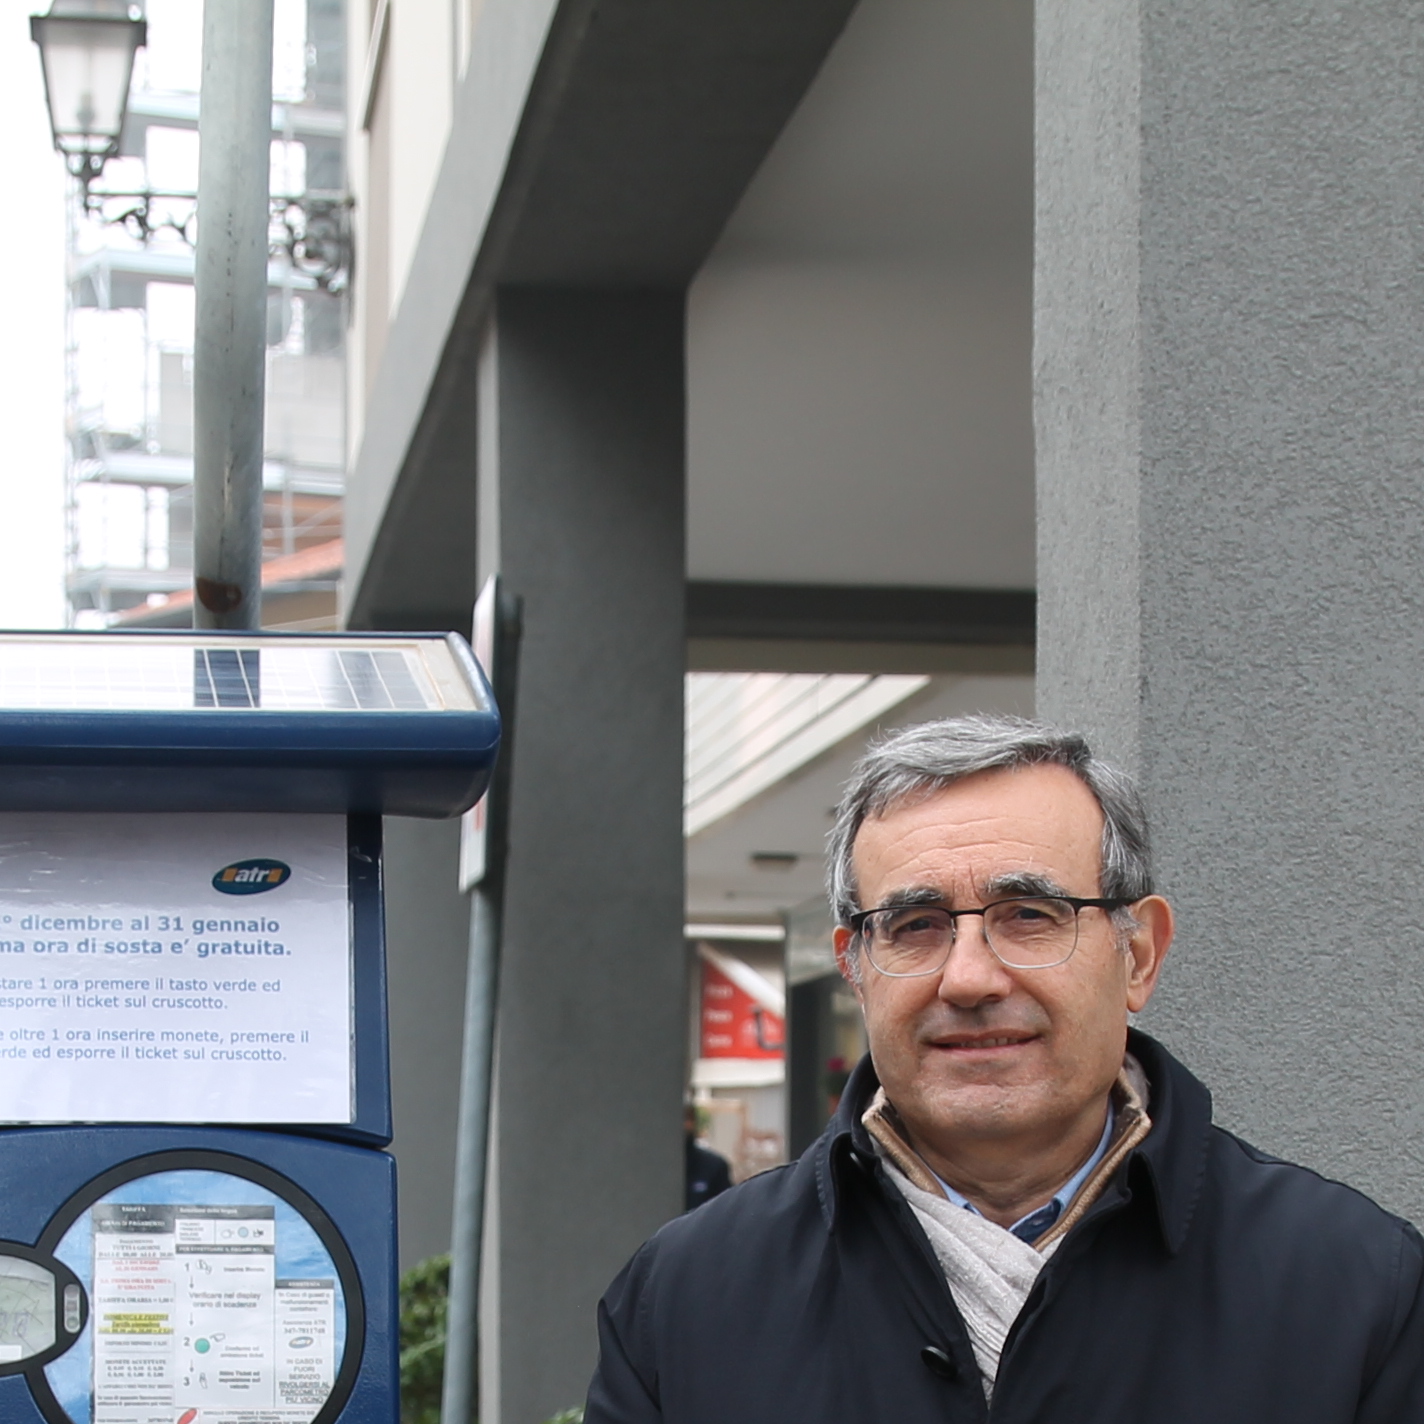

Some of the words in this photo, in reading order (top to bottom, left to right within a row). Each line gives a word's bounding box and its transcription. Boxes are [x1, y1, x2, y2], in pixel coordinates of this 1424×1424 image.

[20, 915, 123, 931] dicembre
[131, 916, 149, 931] al
[157, 916, 184, 931] 31
[192, 917, 280, 935] gennaio
[33, 941, 69, 953] ora
[76, 938, 97, 953] di
[104, 940, 163, 954] sosta
[197, 939, 292, 958] gratuita.
[39, 978, 47, 990] 1
[53, 979, 79, 990] ora
[84, 979, 150, 992] premere
[155, 977, 164, 990] il
[169, 979, 208, 991] tasto
[213, 979, 257, 992] verde
[262, 979, 281, 992] ed
[62, 995, 71, 1007] il
[76, 995, 119, 1008] ticket
[125, 995, 147, 1008] sul
[152, 997, 228, 1009] cruscotto.
[9, 1028, 45, 1041] oltre
[52, 1029, 60, 1041] 1
[66, 1031, 91, 1041] ora
[97, 1028, 155, 1041] inserire
[161, 1030, 224, 1044] monete,
[230, 1031, 296, 1044] premere
[301, 1030, 310, 1043] il
[32, 1046, 51, 1059] ed
[57, 1048, 116, 1061] esporre
[121, 1046, 129, 1059] il
[135, 1046, 177, 1060] ticket
[183, 1047, 205, 1060] sul
[211, 1049, 287, 1061] cruscotto.
[184, 1262, 190, 1272] 1
[236, 1292, 261, 1300] display
[183, 1337, 190, 1347] 2
[183, 1377, 190, 1386] 3
